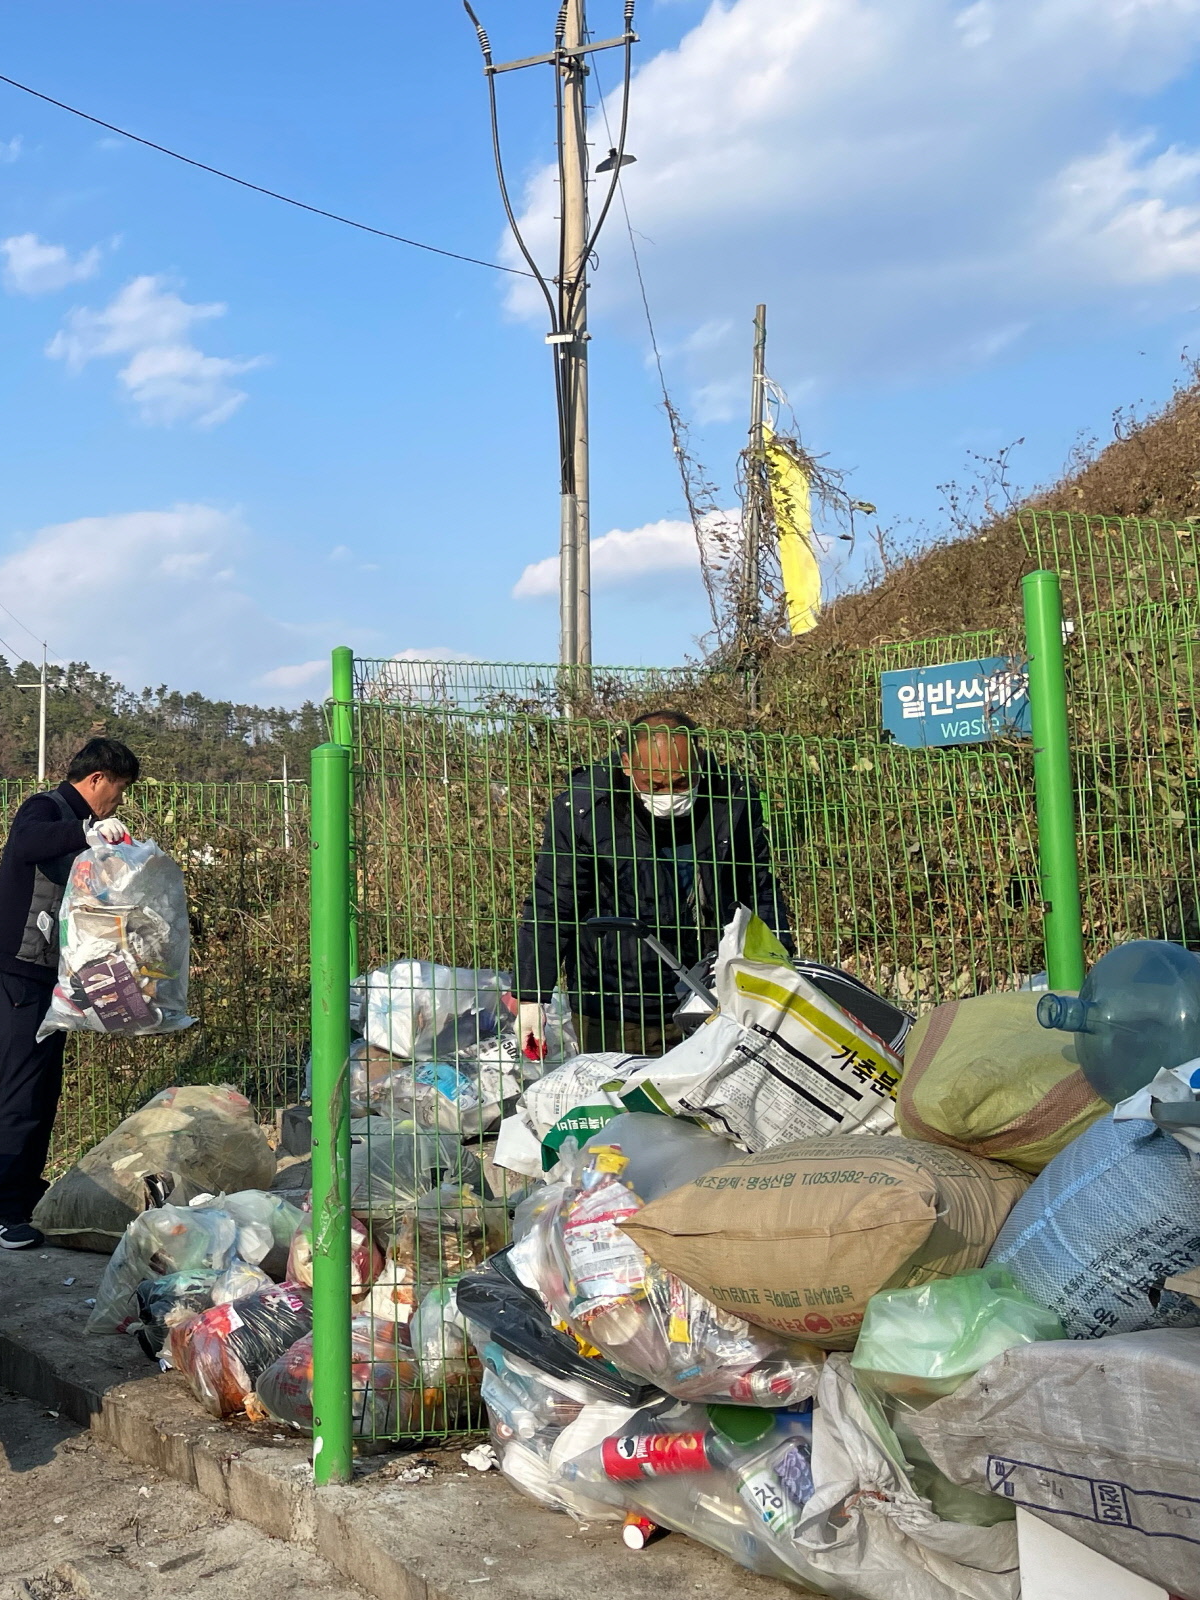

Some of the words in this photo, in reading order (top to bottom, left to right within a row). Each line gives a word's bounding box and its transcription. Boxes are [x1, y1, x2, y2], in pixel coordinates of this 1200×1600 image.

[941, 715, 1000, 739] waste
[831, 1045, 898, 1103] 가축분
[753, 1482, 784, 1509] 참
